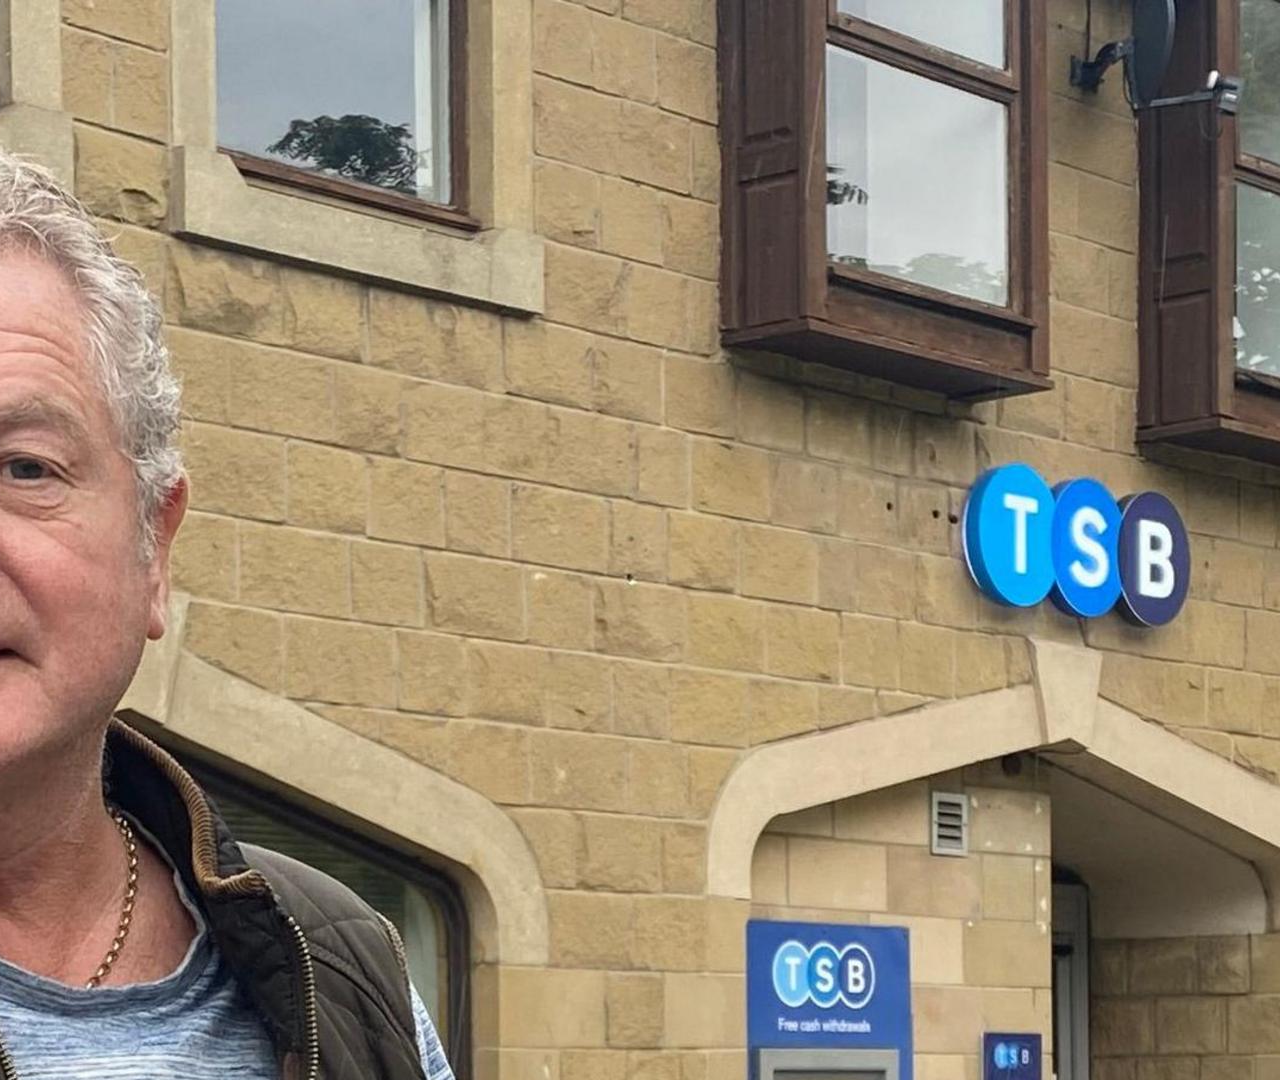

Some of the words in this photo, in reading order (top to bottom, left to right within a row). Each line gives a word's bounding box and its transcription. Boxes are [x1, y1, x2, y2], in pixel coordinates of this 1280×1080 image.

[1003, 492, 1175, 599] TSB
[785, 957, 866, 994] TSB
[777, 1017, 799, 1032] Free
[800, 1018, 821, 1032] cash
[822, 1018, 872, 1033] withdrawals
